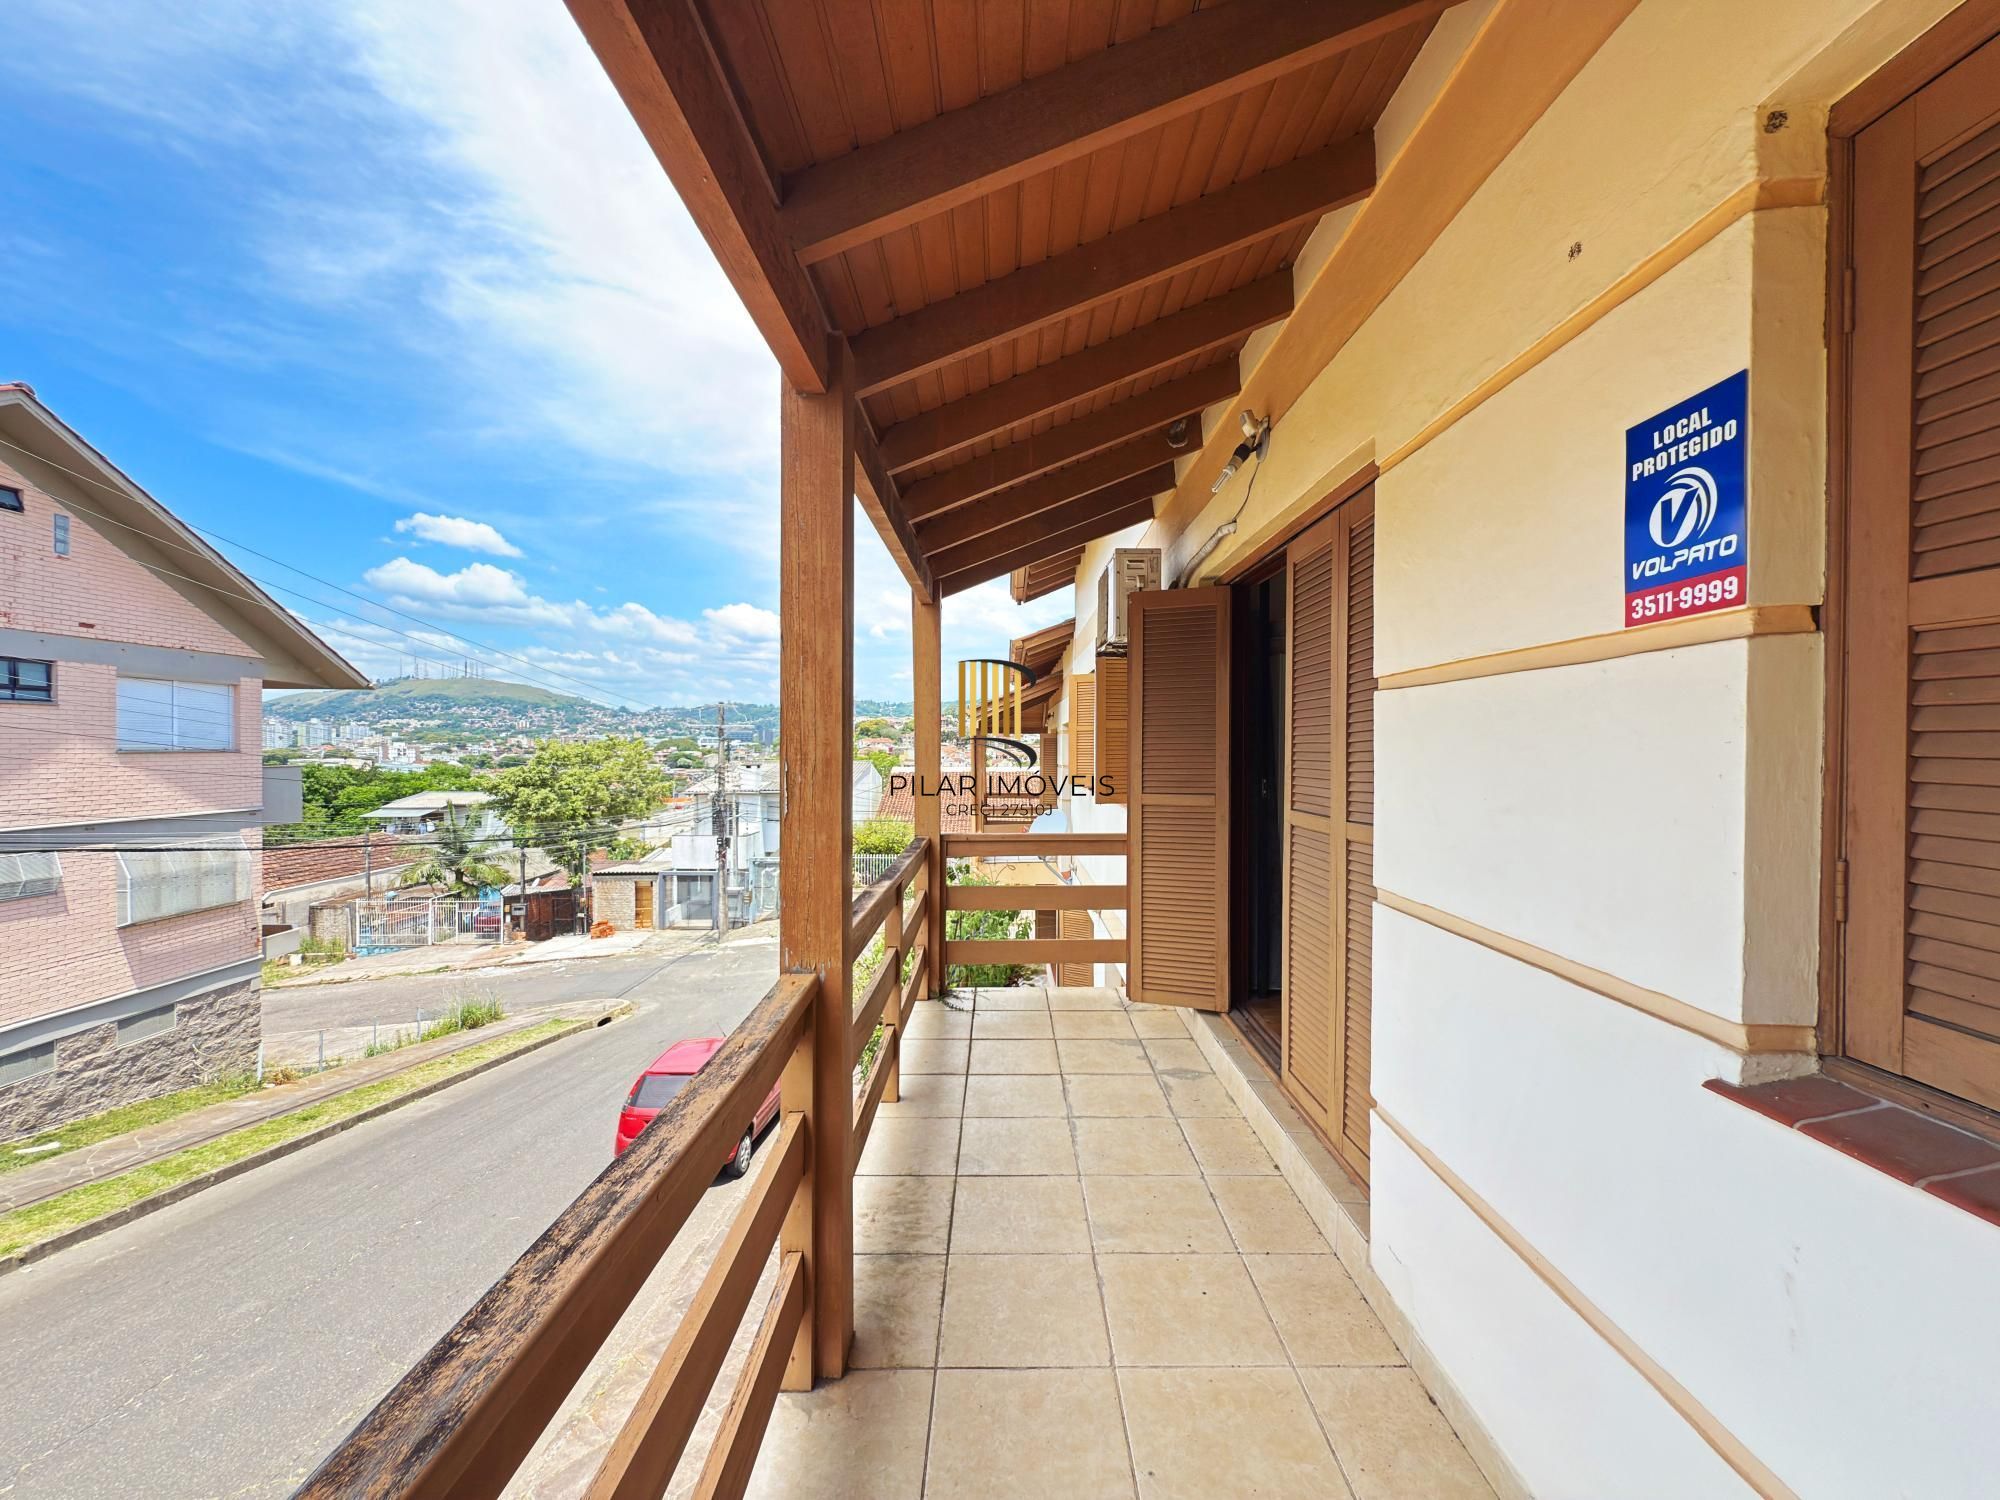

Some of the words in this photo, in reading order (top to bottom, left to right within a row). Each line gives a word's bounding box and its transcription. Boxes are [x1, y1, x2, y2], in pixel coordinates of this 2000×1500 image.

[1632, 418, 1737, 481] PROTEGIDO
[1653, 407, 1712, 450] LOCAL
[1632, 534, 1738, 580] VOLPATO
[1631, 575, 1738, 619] 3511-9999
